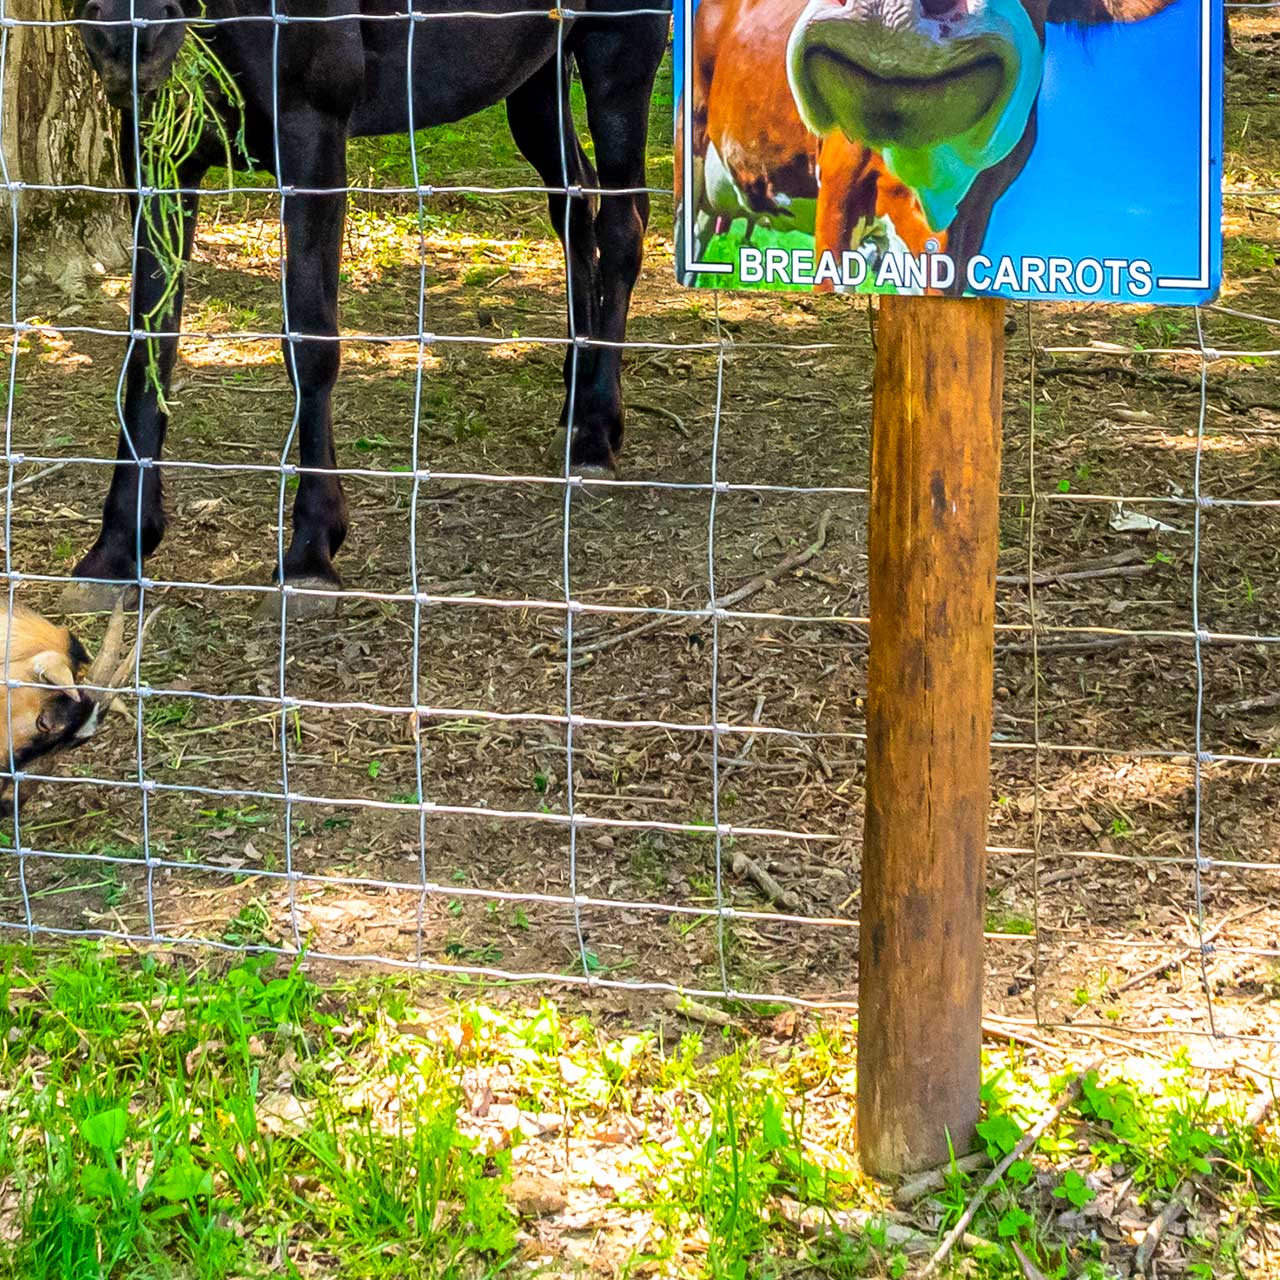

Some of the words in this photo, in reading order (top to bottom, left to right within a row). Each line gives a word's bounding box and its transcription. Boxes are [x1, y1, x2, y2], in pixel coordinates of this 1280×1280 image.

[739, 248, 867, 286] BREAD
[876, 251, 955, 289] AND
[967, 255, 1153, 296] CARROTS
